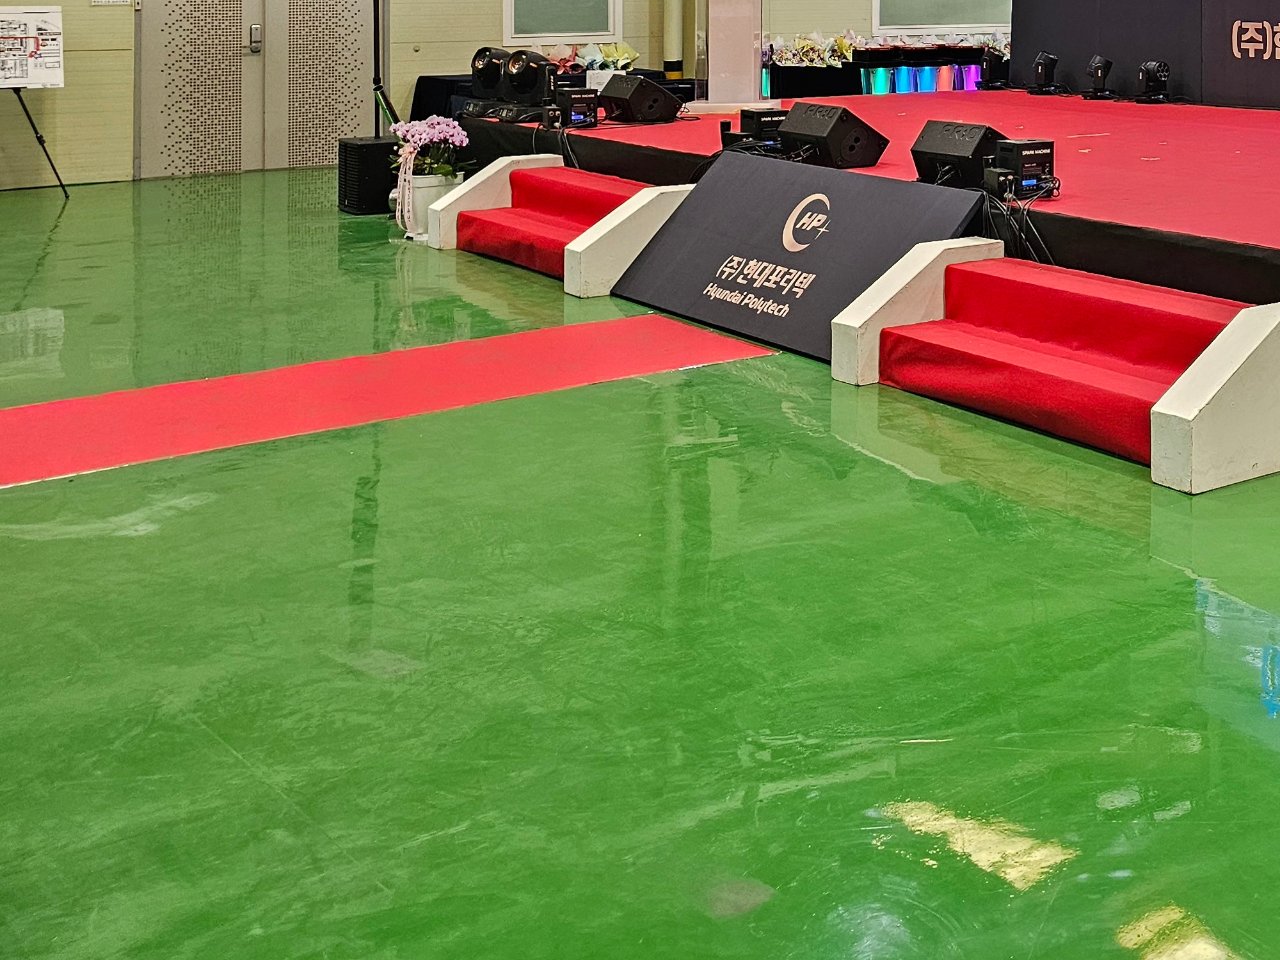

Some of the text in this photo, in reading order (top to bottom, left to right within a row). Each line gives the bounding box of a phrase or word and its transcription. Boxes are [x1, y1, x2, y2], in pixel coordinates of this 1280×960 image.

[716, 254, 817, 299] (주)현대포리텍
[703, 282, 790, 318] Hyundai Polytech
